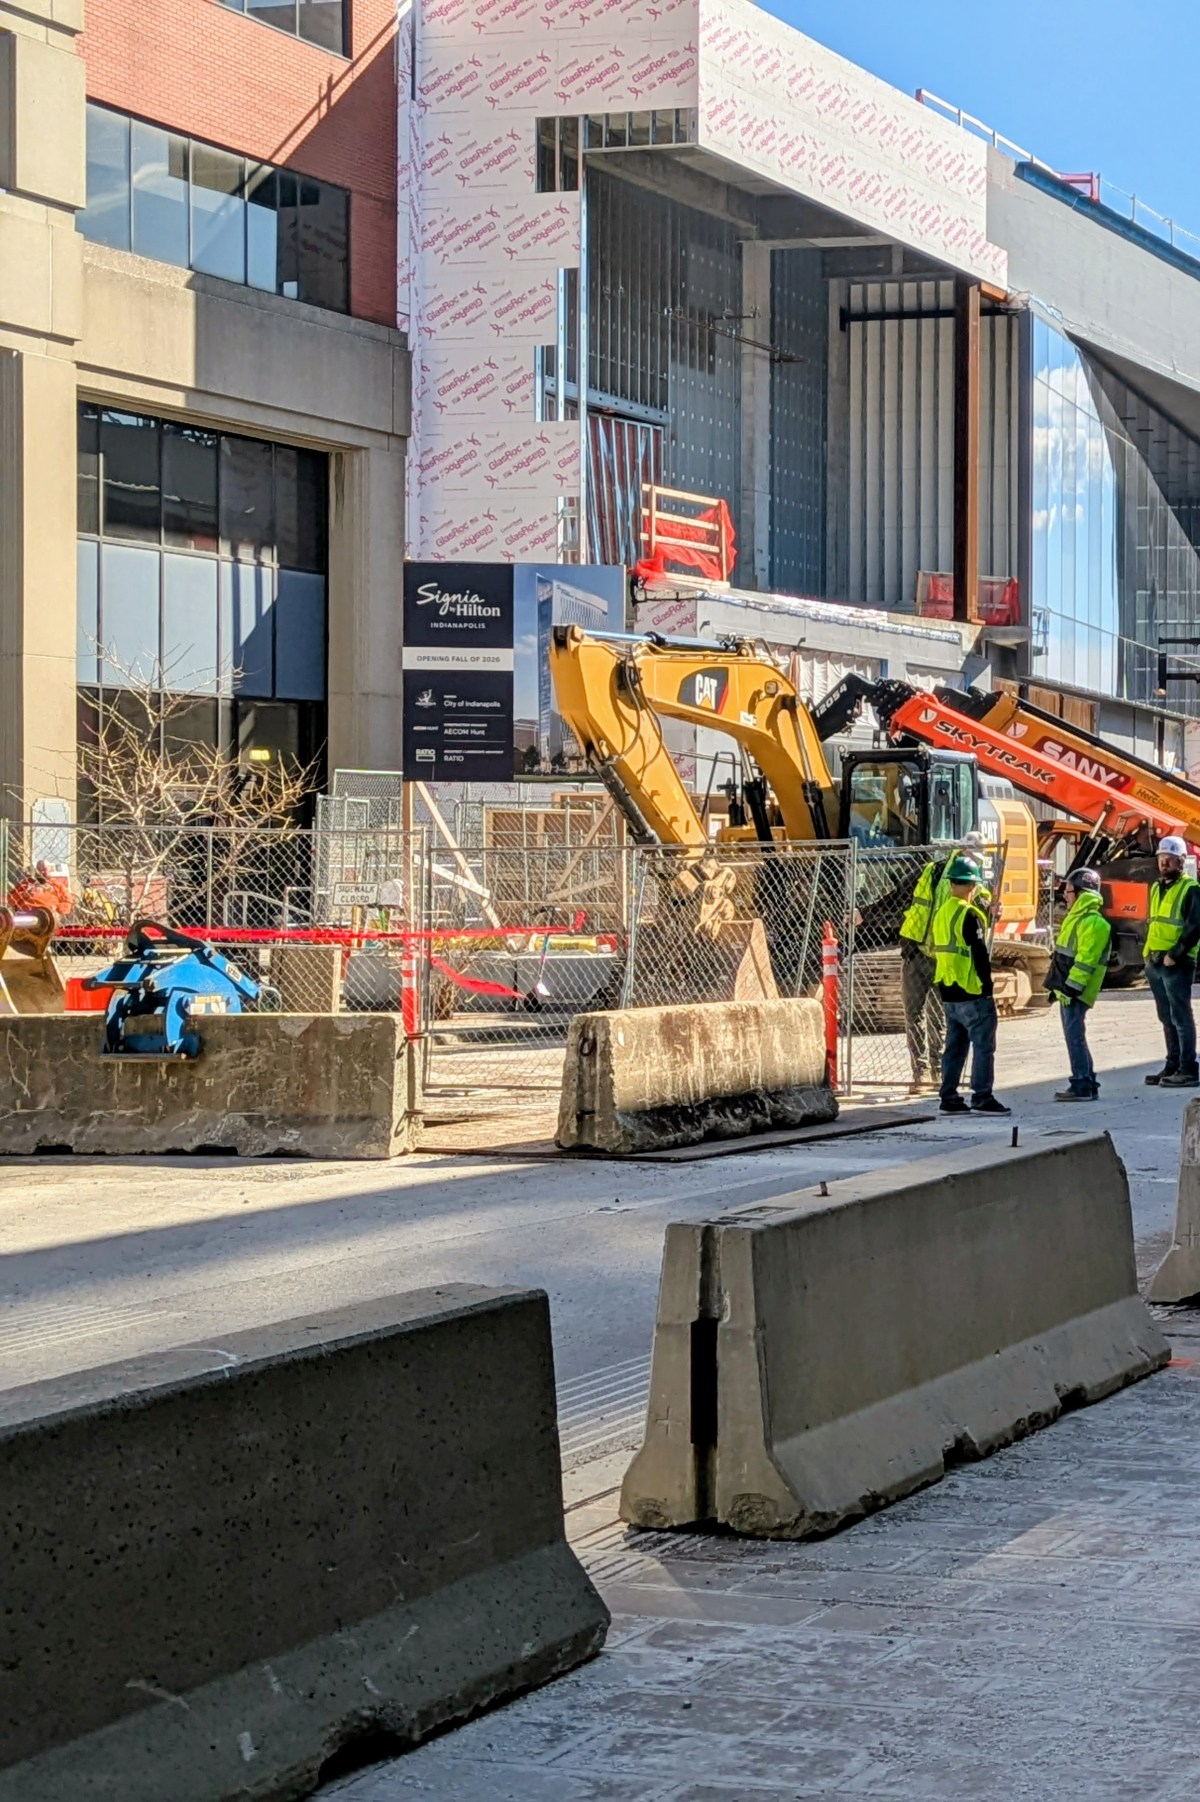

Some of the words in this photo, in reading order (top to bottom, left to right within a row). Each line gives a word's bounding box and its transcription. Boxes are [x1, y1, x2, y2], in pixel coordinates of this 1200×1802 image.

[476, 0, 501, 16] Glas
[506, 372, 534, 394] GlasRo
[557, 449, 580, 469] GlasR
[416, 583, 485, 616] Signia
[456, 604, 501, 617] Hilton
[695, 673, 717, 710] CAT
[443, 700, 457, 708] City
[465, 701, 501, 709] Indianapolis
[934, 719, 1056, 784] SKYTRAK
[1041, 741, 1119, 788] SANY
[981, 820, 998, 843] CAT
